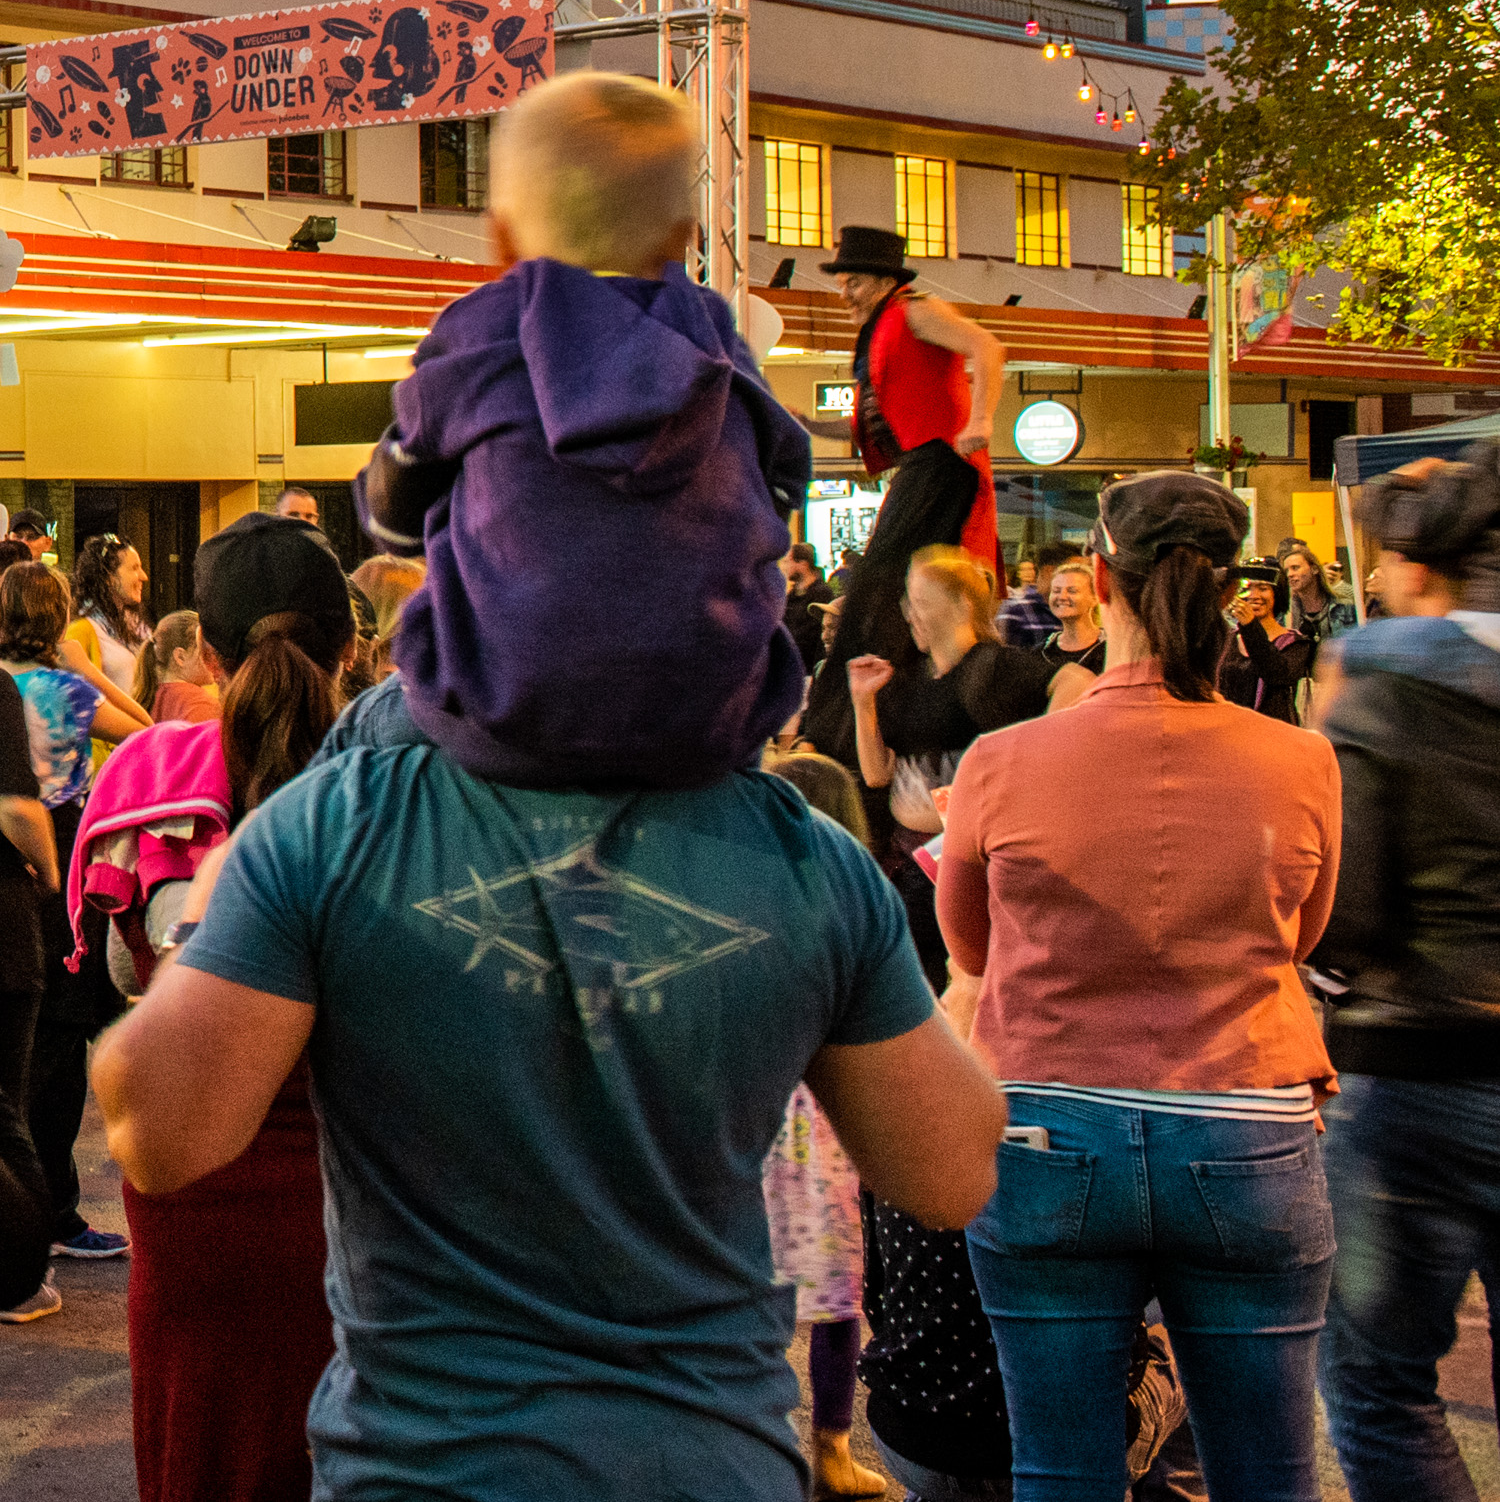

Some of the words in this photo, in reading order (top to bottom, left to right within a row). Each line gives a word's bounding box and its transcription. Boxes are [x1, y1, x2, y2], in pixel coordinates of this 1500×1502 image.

[242, 32, 288, 47] WELCOME
[289, 29, 301, 39] TO
[234, 48, 294, 80] DOWN
[231, 75, 315, 113] UNDER
